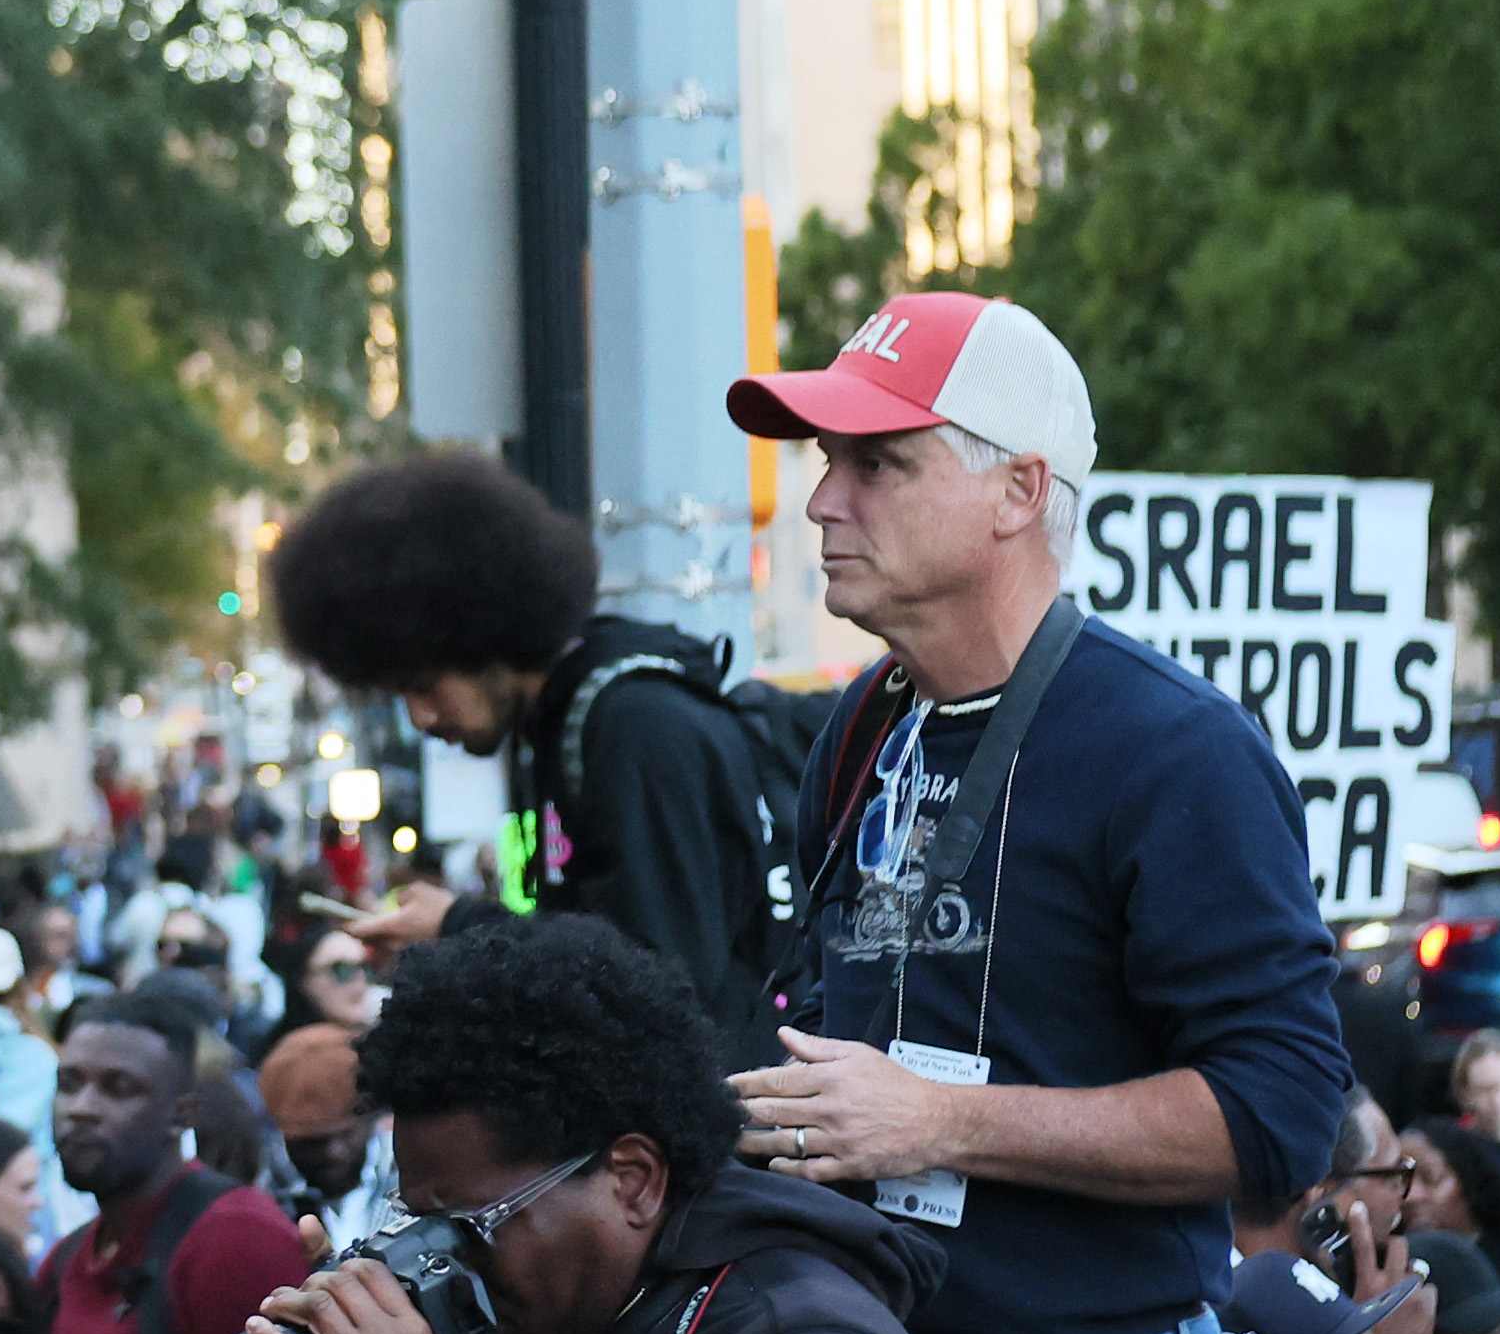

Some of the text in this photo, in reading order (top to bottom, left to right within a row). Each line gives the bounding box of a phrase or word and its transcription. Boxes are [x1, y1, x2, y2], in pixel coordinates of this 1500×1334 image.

[1064, 493, 1388, 613] SRAEL
[1145, 639, 1438, 751] TROLS
[879, 1192, 958, 1219] ESS PRESS
